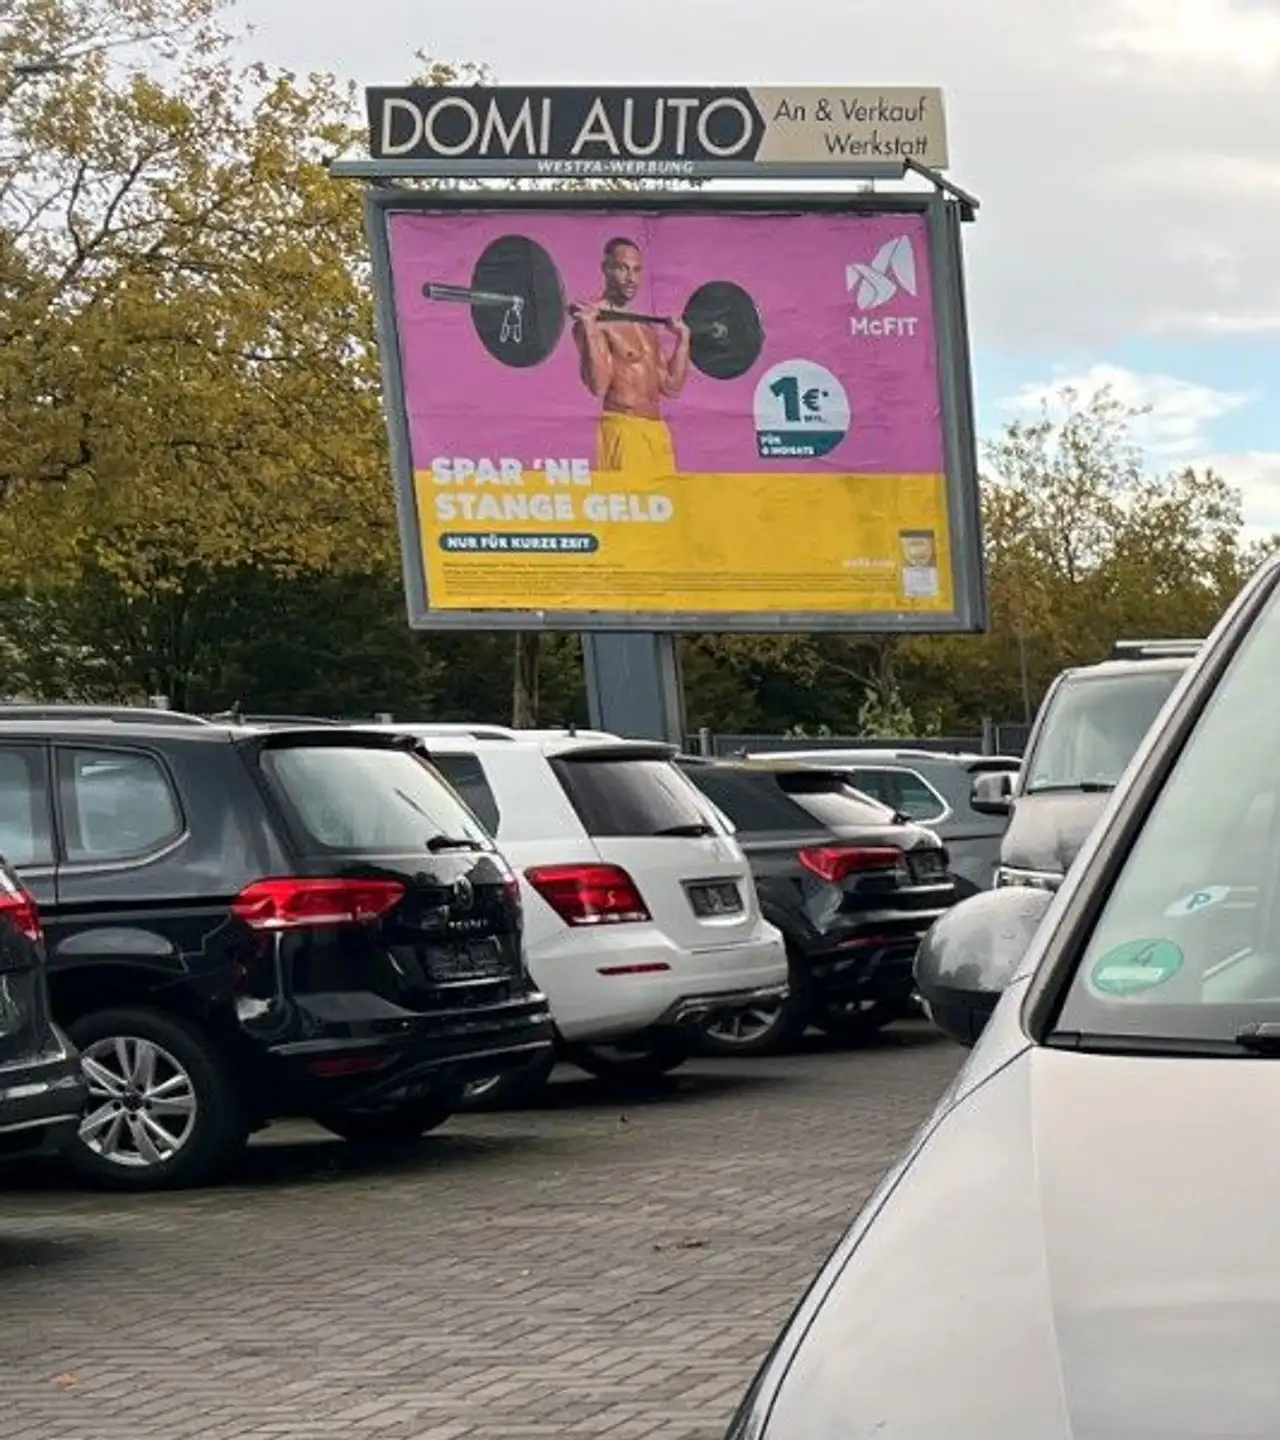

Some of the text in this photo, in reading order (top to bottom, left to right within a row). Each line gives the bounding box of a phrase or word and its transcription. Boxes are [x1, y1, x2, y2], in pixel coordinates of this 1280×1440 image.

[774, 97, 929, 124] An & Verkauf
[380, 96, 755, 158] DOMI AUTO
[824, 130, 929, 157] Werkstatt
[849, 318, 918, 338] McFIT
[431, 457, 524, 486] SPAR
[435, 492, 674, 523] STANGE GELD
[447, 533, 591, 550] NUR FÜR KURZE ZEIT
